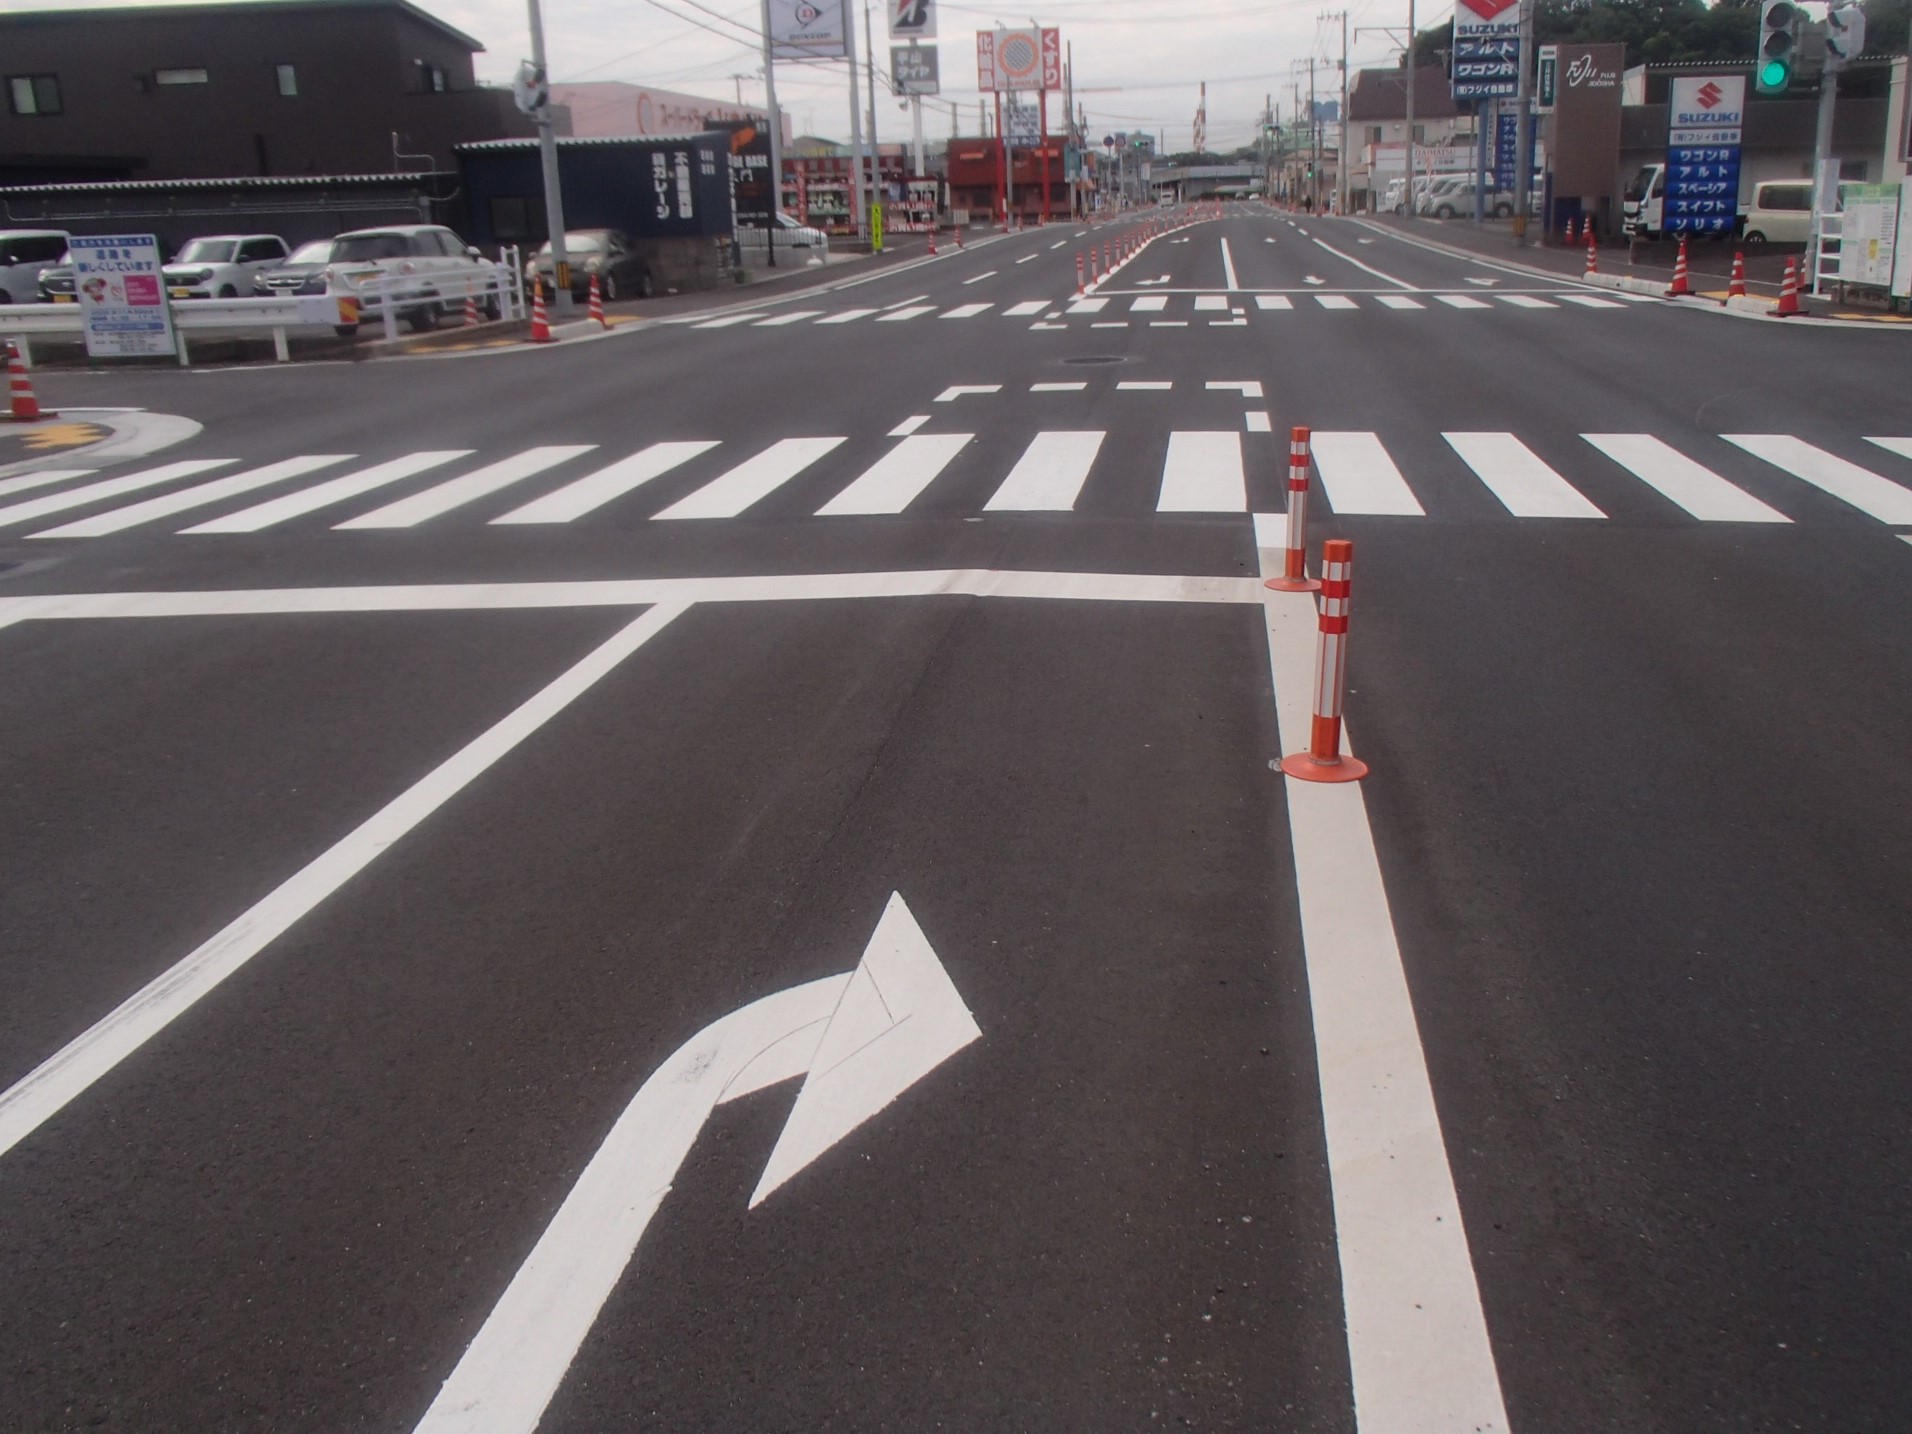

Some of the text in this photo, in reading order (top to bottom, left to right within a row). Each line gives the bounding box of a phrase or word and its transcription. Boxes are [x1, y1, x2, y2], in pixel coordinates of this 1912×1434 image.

[1457, 23, 1519, 35] SUZUKI
[1459, 42, 1515, 56] アルト
[1043, 31, 1059, 85] くすり
[897, 65, 930, 79] タイヤ
[1457, 64, 1514, 76] ワゴンR
[1678, 112, 1739, 123] SUZUKI
[1680, 150, 1730, 162] ワゴンR
[1679, 166, 1728, 178] アルト
[1678, 183, 1728, 195] スペーシア
[1677, 200, 1726, 212] スイフト
[1676, 218, 1724, 230] ソリオ
